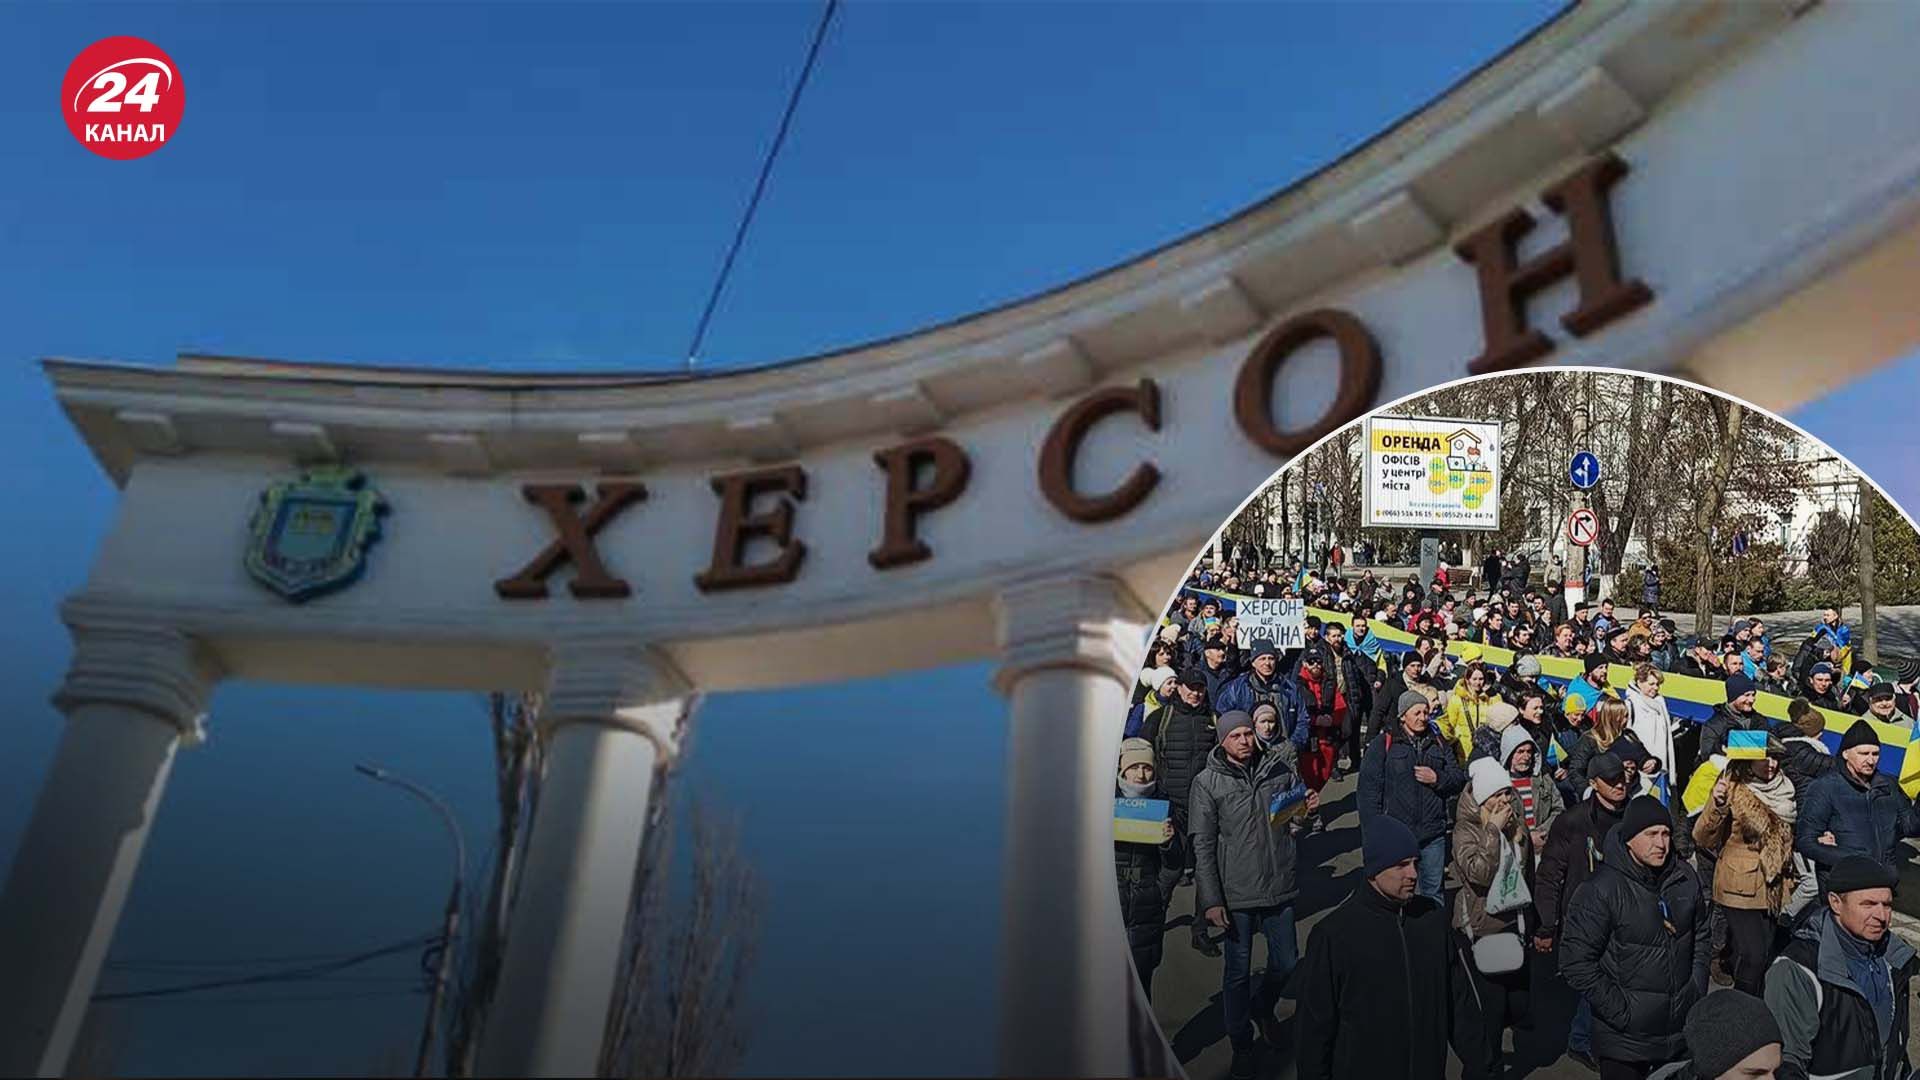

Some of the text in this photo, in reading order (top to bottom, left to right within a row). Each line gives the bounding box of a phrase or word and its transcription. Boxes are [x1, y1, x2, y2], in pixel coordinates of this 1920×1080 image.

[496, 152, 1655, 600] ХЕРСОН
[1382, 435, 1441, 451] ОРЕНДА
[1382, 454, 1420, 466] ОФІСІВ
[1382, 467, 1426, 480] у центрі
[1382, 480, 1411, 491] міста
[1260, 617, 1274, 626] це
[1240, 624, 1302, 646] УКРАЇНА
